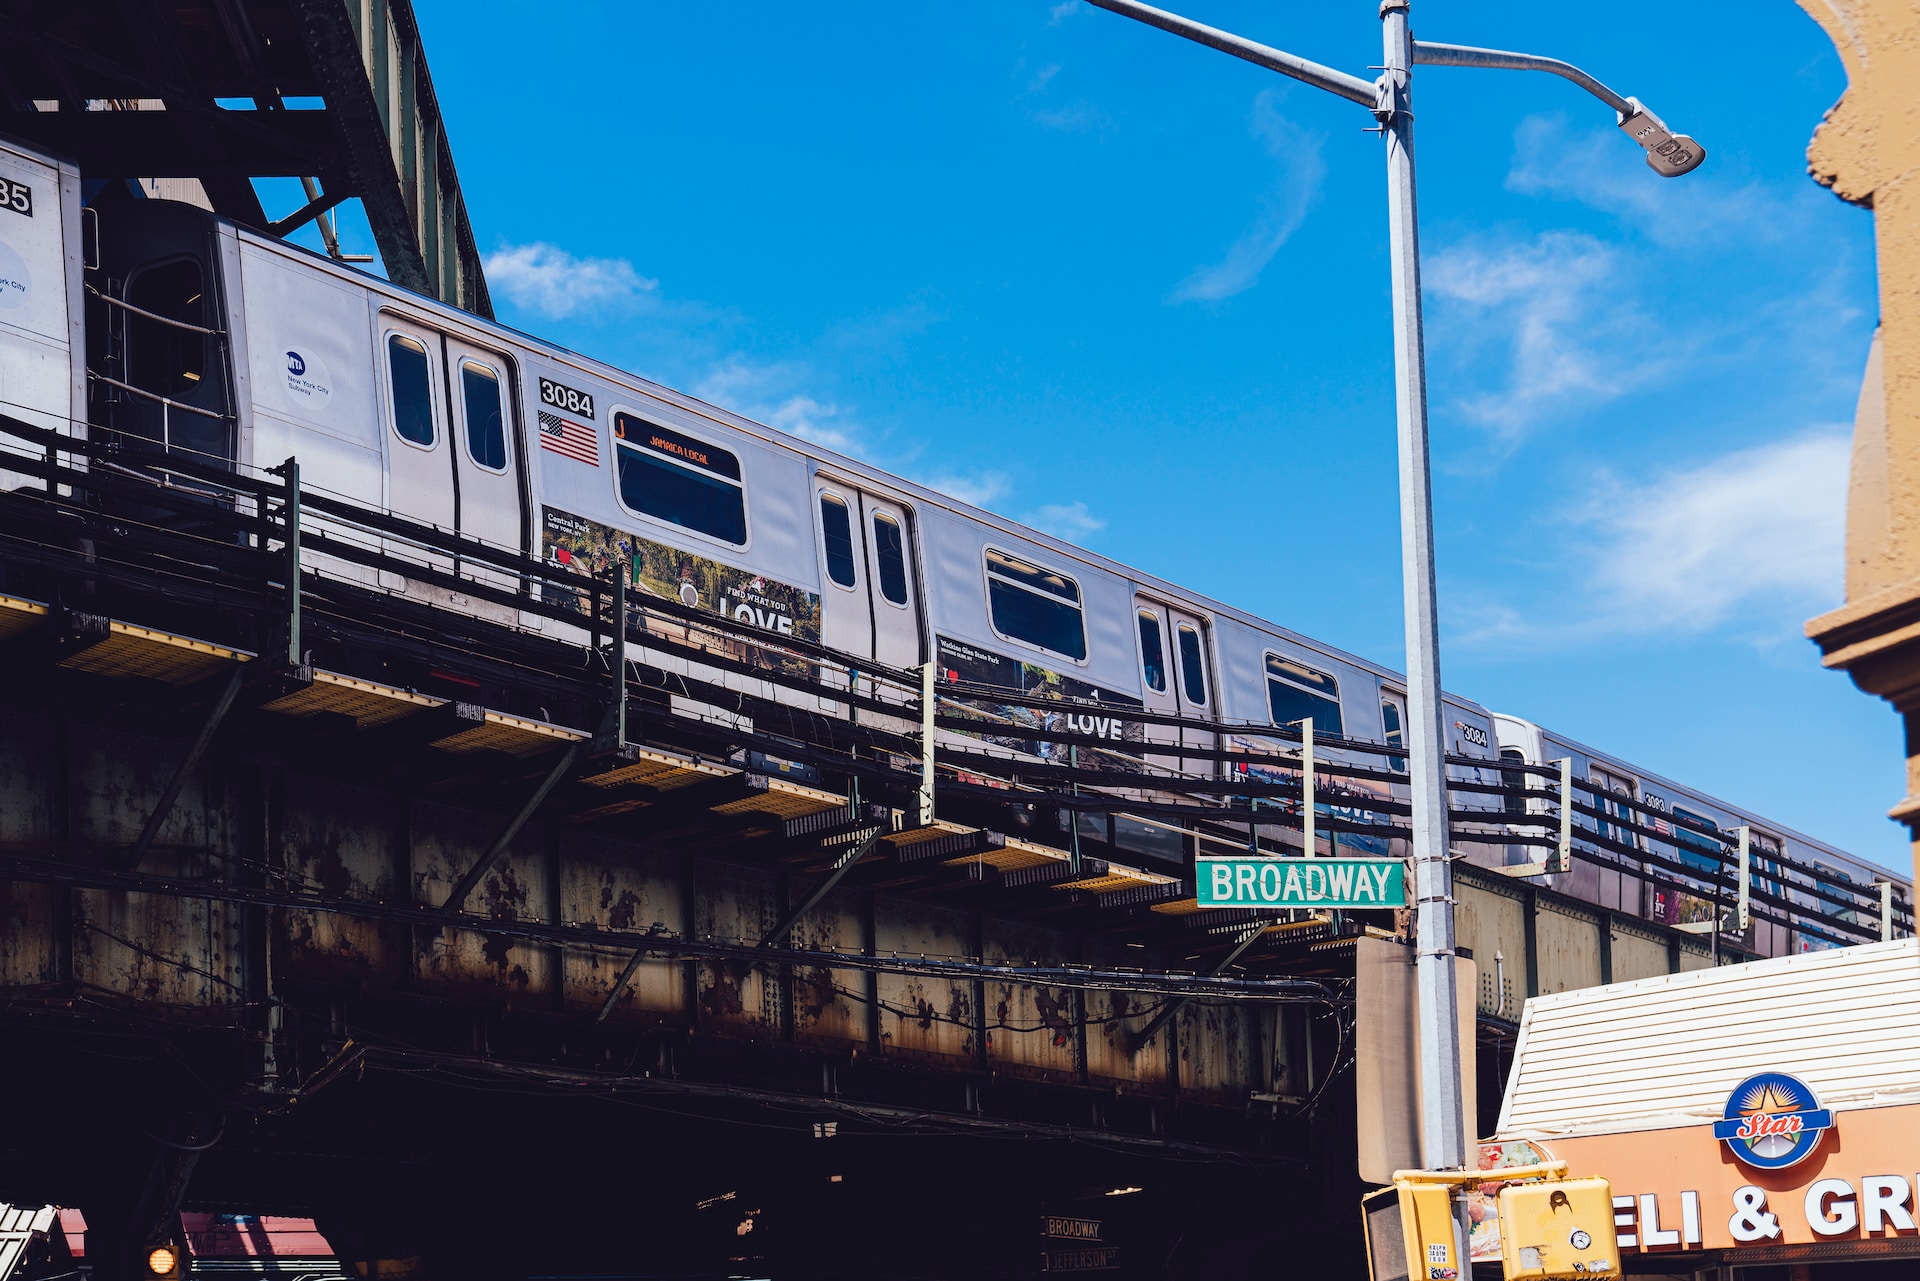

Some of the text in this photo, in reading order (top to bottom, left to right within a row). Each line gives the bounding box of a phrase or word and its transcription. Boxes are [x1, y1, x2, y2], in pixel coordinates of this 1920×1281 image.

[11, 281, 26, 292] City
[287, 375, 329, 395] New York City
[288, 383, 311, 396] Subway
[541, 380, 593, 417] 3084
[615, 419, 626, 439] J
[650, 436, 709, 465] JAMAICA LOCAL
[547, 513, 591, 534] Central Park
[548, 522, 559, 530] NEW
[550, 545, 557, 562] I
[727, 586, 786, 612] FIND WHAT YOU
[987, 655, 1000, 665] Park
[1067, 713, 1122, 740] LOVE
[1463, 726, 1487, 747] 3084
[1645, 794, 1666, 812] 3083
[1211, 864, 1393, 902] BROADWAY
[1655, 902, 1665, 914] NY
[1737, 1112, 1803, 1138] Star
[1728, 1185, 1781, 1242] &
[1804, 1173, 1920, 1236] GR
[1048, 1218, 1100, 1238] BROADWAY
[1052, 1250, 1116, 1269] JEFFERSON ST
